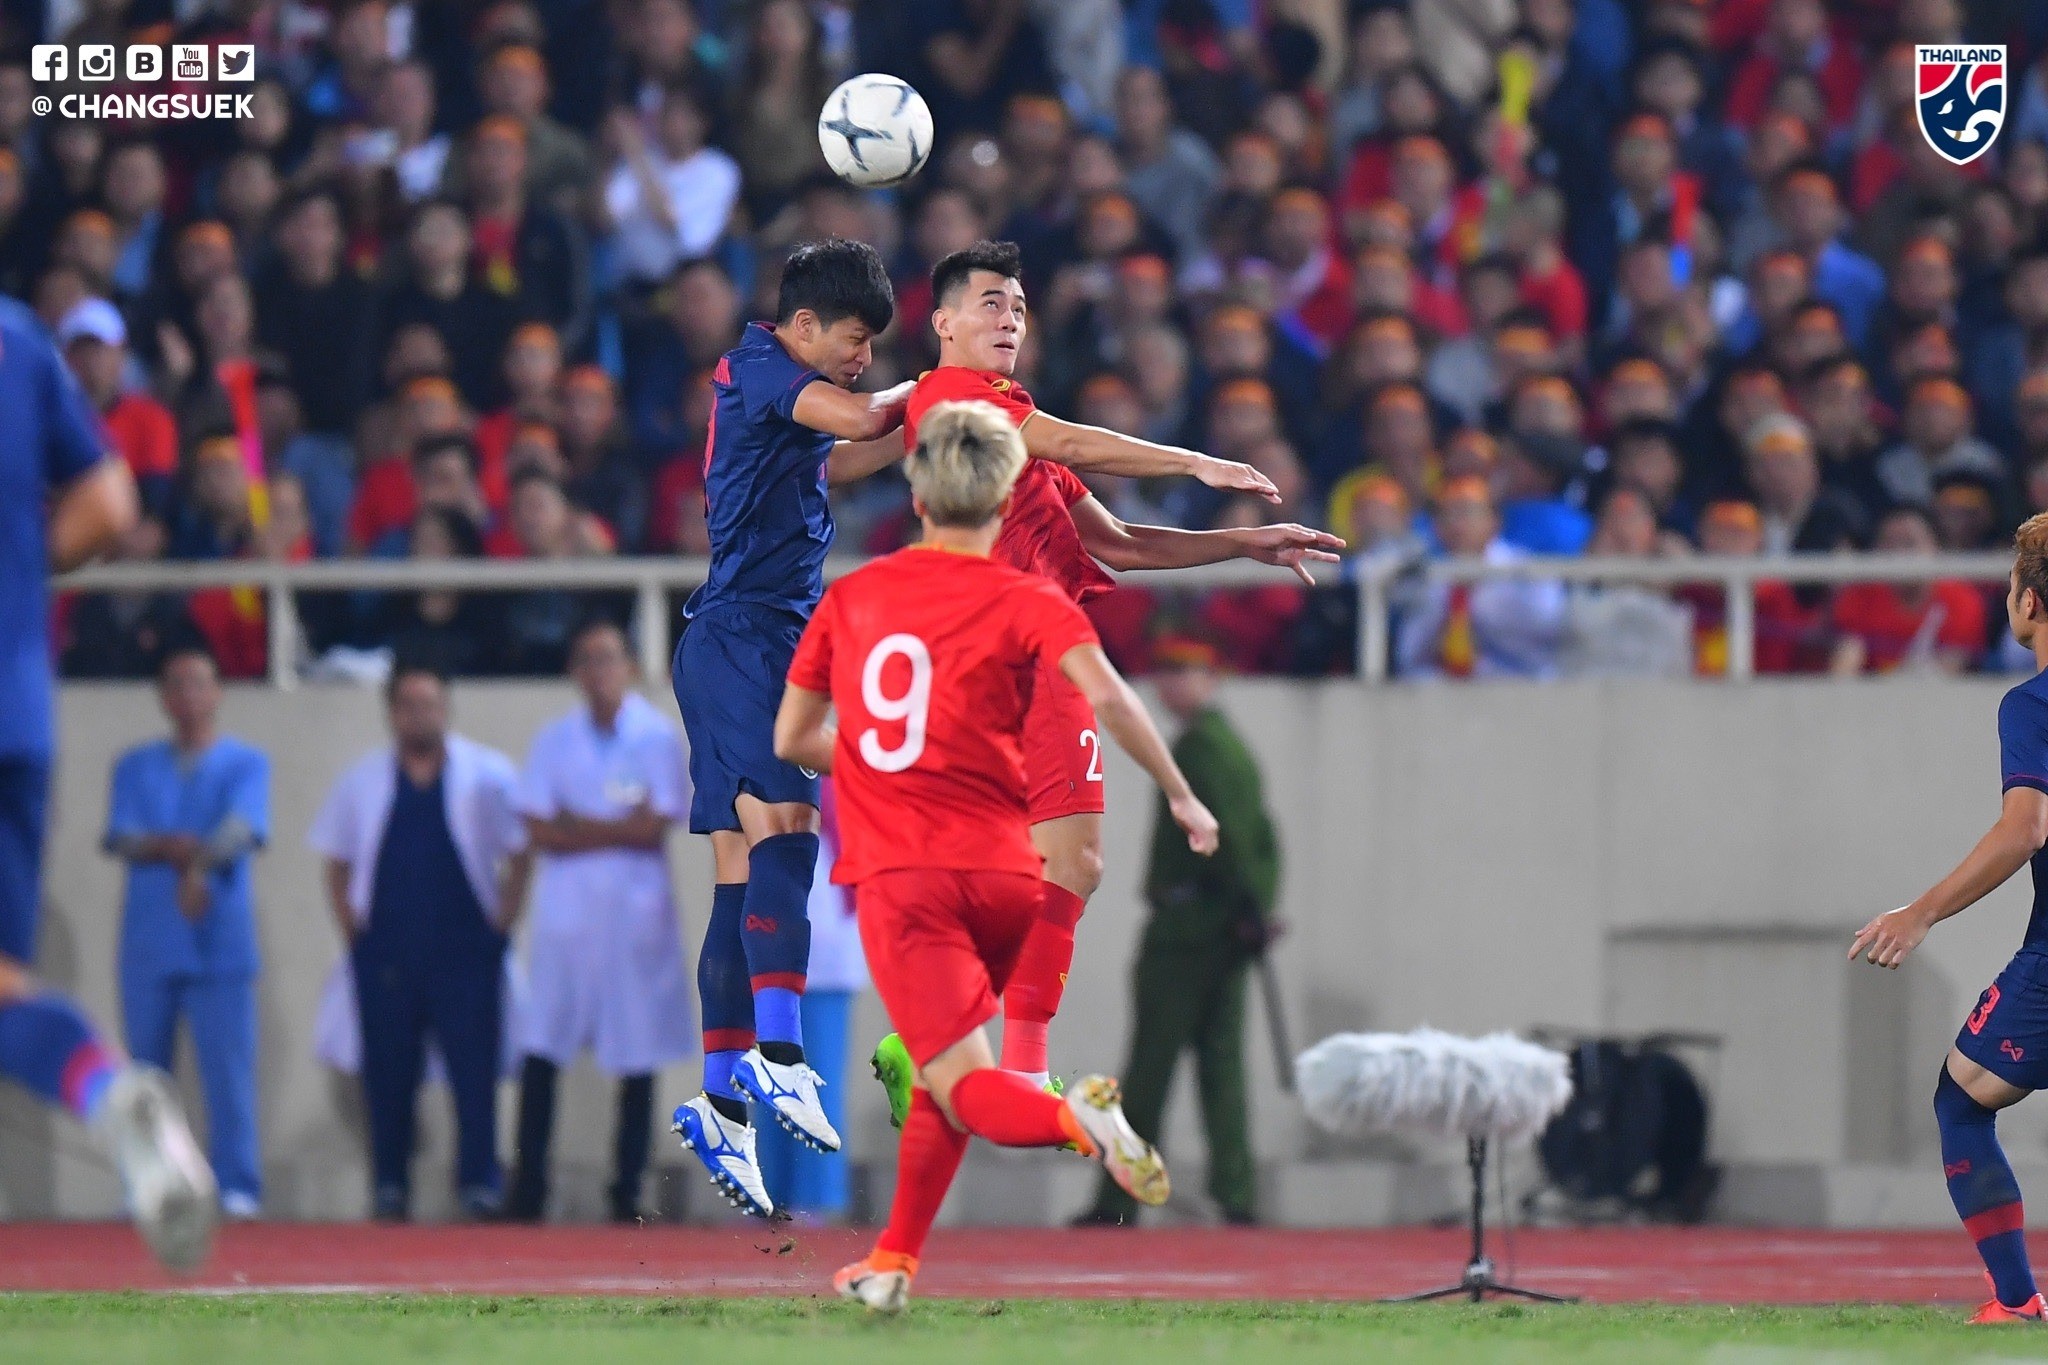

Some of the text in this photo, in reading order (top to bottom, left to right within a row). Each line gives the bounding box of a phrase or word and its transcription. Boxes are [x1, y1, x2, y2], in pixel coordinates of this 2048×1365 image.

[858, 632, 934, 774] 9
[1079, 728, 1103, 782] 2
[1966, 983, 2001, 1036] 3
